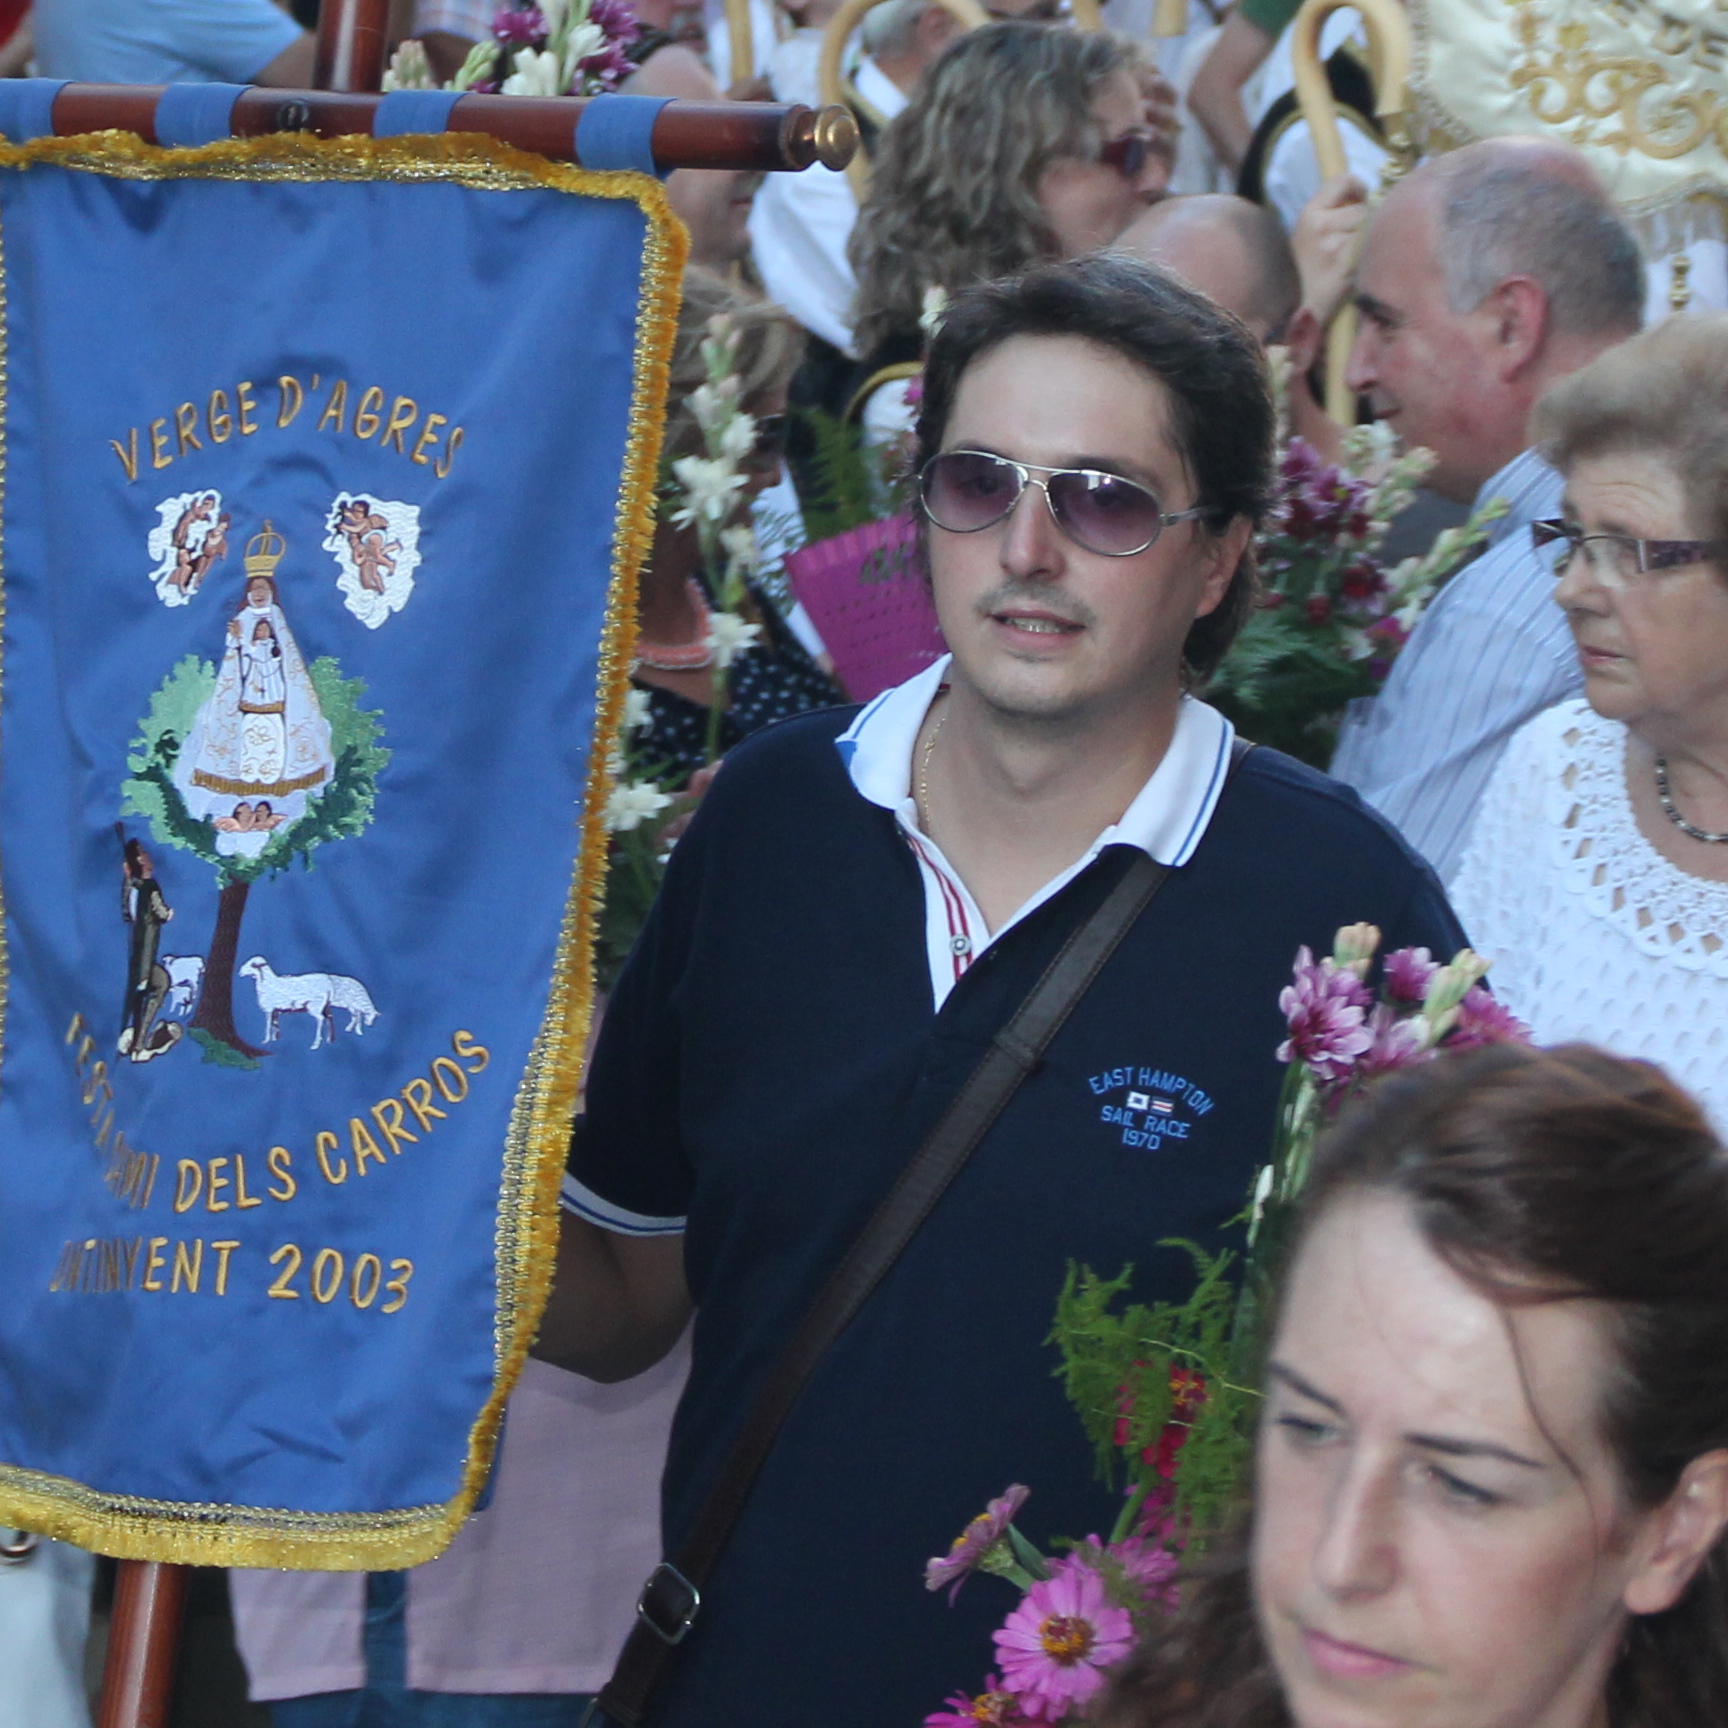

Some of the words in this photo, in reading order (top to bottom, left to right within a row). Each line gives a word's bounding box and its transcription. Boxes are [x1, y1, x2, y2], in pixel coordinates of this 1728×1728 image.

[108, 381, 258, 485] VERGE
[277, 373, 464, 479] D'AGRES
[173, 1146, 296, 1213] DELS
[316, 1029, 490, 1185] CARROS
[1088, 1066, 1134, 1095] EAST
[1138, 1067, 1215, 1117] HAMPTON
[1101, 1105, 1135, 1128] SAIL
[1144, 1115, 1190, 1139] RACE
[1122, 1128, 1162, 1151] 1970
[267, 1243, 414, 1314] 2003
